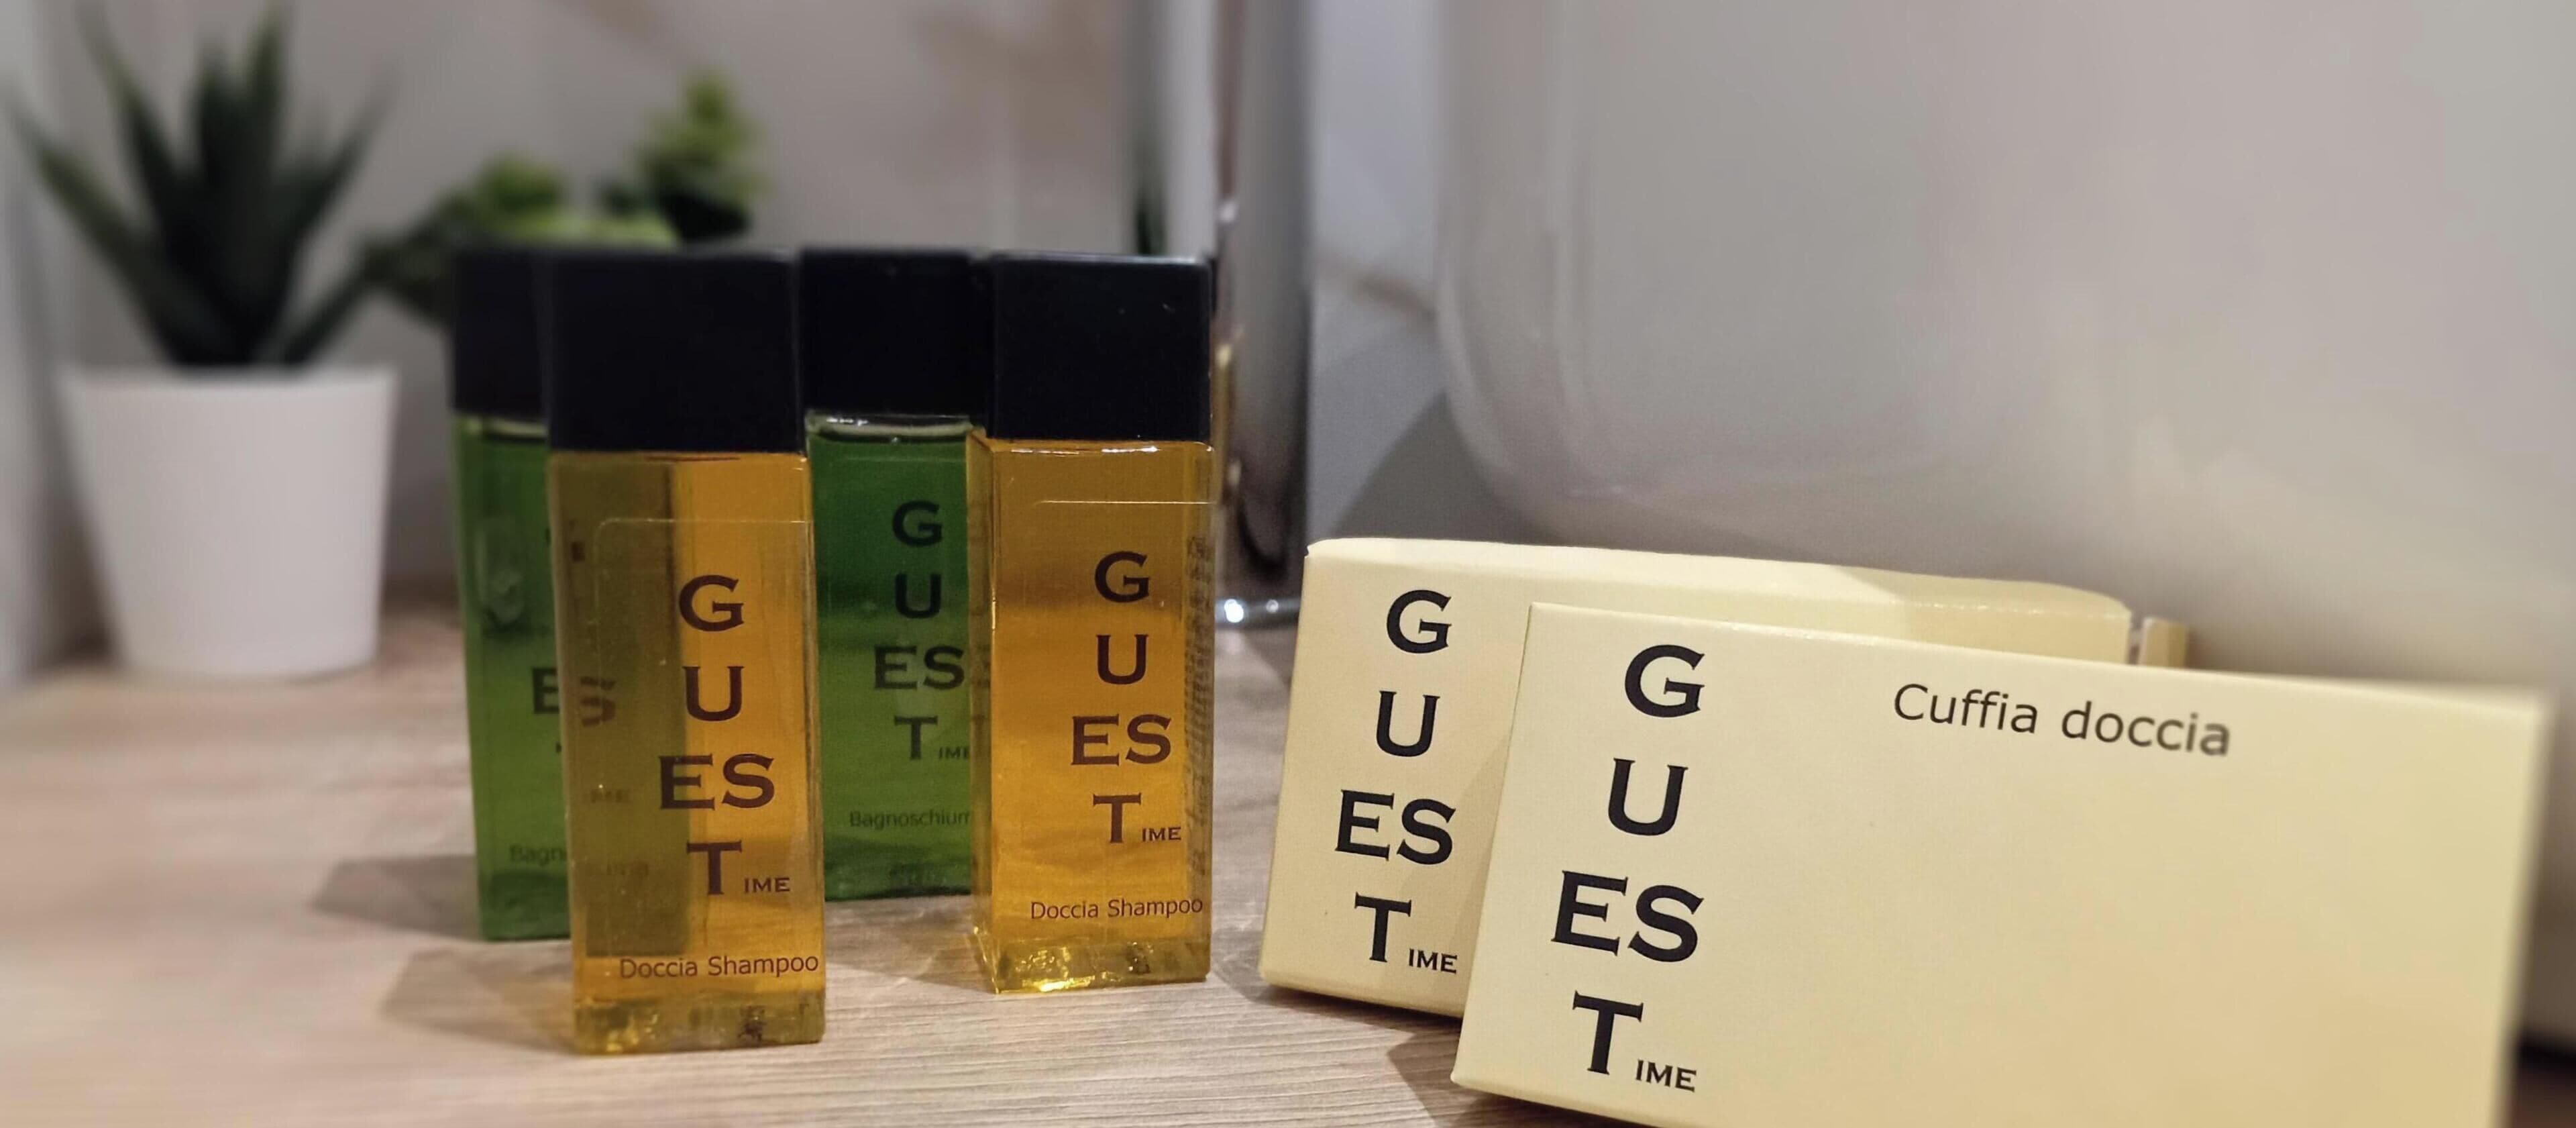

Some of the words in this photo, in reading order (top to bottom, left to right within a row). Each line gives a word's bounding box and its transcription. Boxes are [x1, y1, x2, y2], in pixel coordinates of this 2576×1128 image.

[1893, 683, 2039, 734] Cuffia
[2061, 701, 2231, 757] doccia
[1031, 900, 1099, 919] Doccia
[1108, 897, 1203, 919] Shampoo
[620, 958, 698, 979] Doccia
[708, 954, 819, 977] Shampoo
